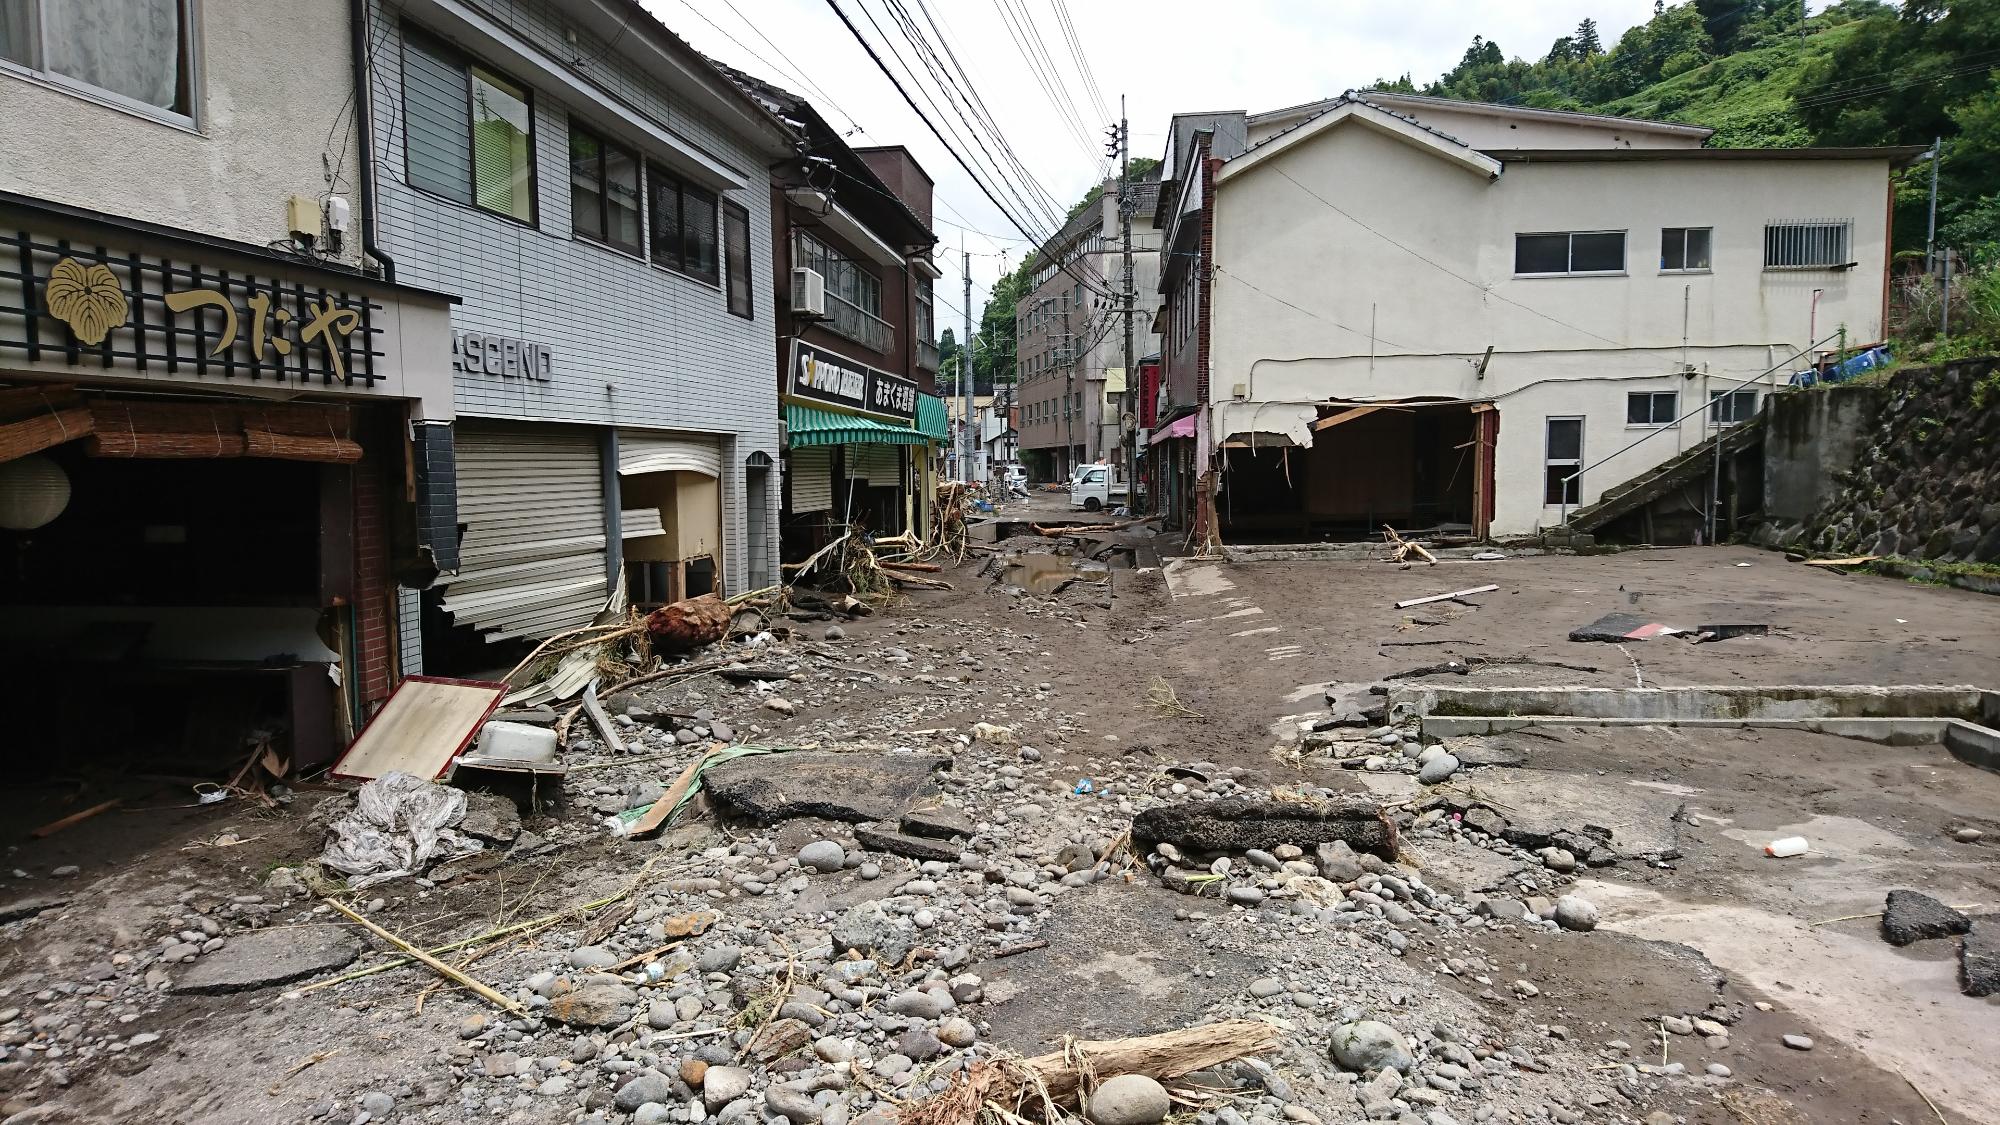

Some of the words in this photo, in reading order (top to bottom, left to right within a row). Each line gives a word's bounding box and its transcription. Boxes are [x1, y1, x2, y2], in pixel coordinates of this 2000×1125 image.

[164, 289, 360, 381] つたや
[451, 329, 552, 382] ASCEND
